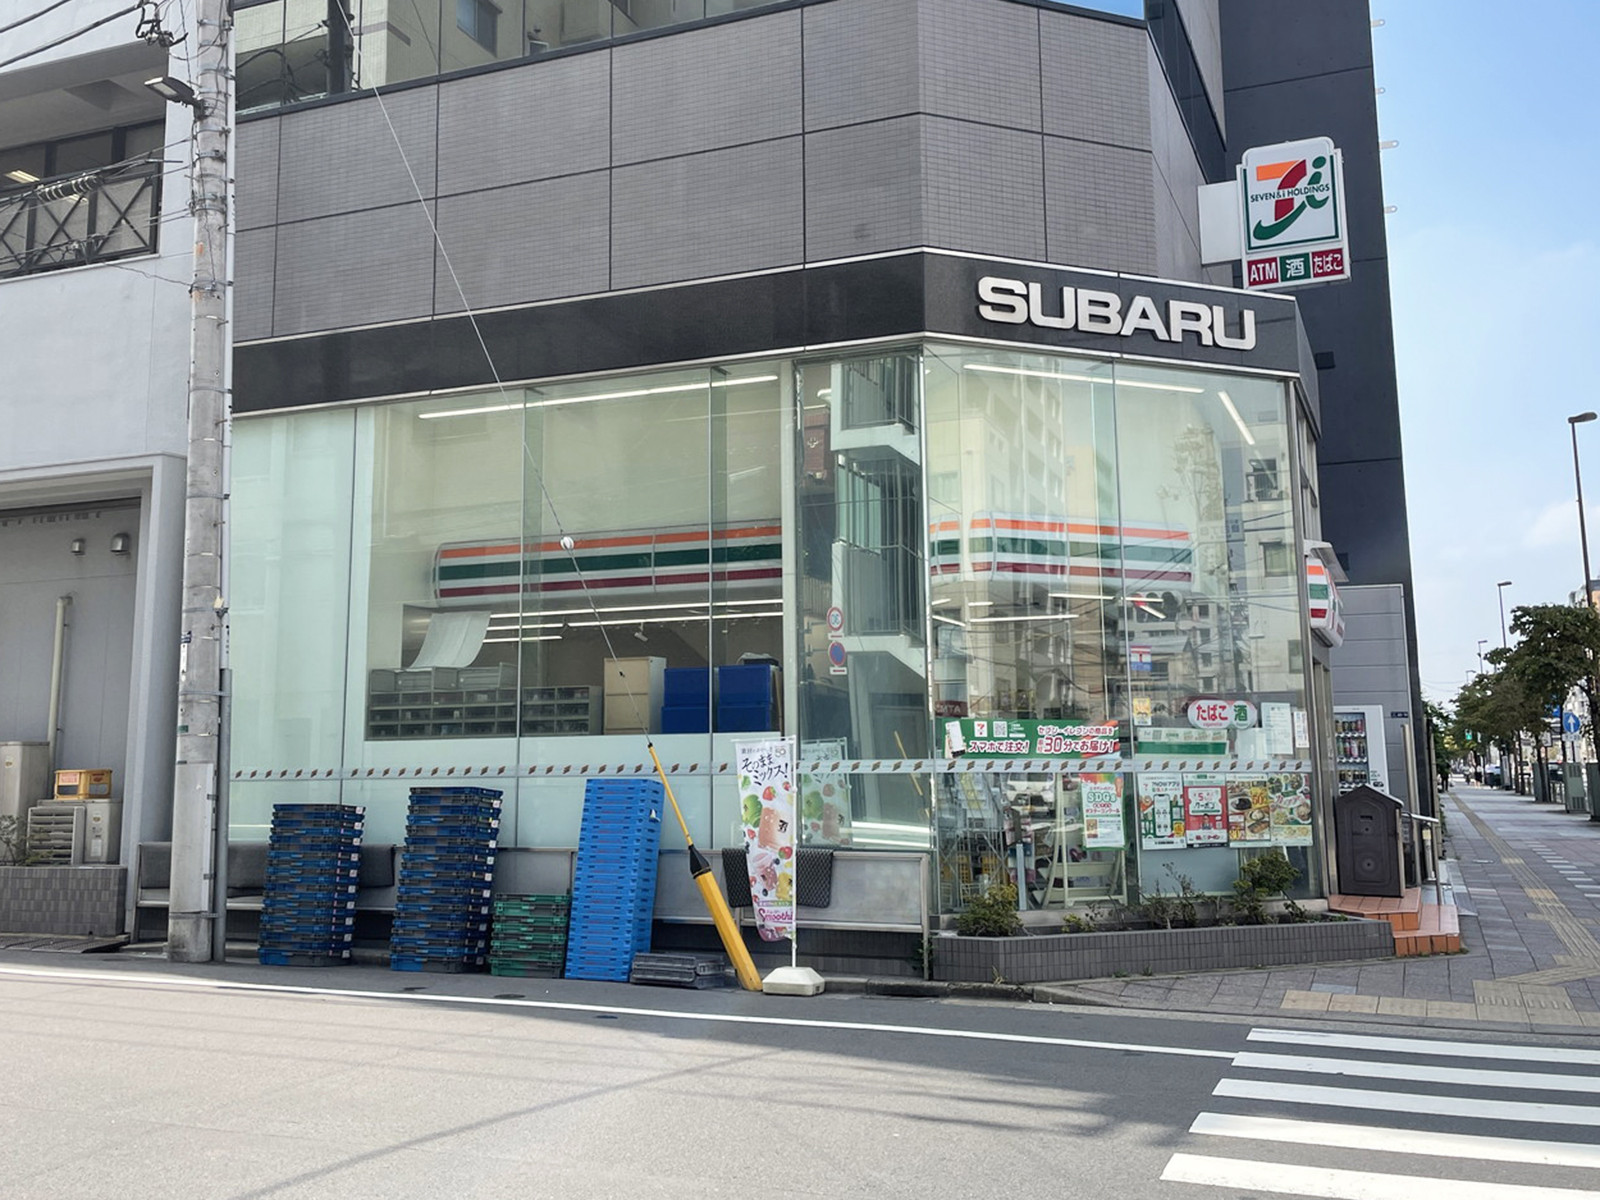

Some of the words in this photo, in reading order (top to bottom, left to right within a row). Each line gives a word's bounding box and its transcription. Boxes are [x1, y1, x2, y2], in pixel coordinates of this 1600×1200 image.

[1287, 183, 1330, 197] HOLDINGS
[1250, 262, 1277, 283] ATM
[1286, 257, 1305, 279] 酒
[1313, 254, 1343, 275] たばこ
[977, 276, 1257, 351] SUBARU
[1196, 704, 1229, 721] たばこ
[1233, 704, 1248, 721] 酒
[741, 754, 774, 773] そのまま
[753, 762, 789, 786] ミックス!
[1087, 791, 1117, 803] SDGs
[758, 907, 793, 922] Smoothi
